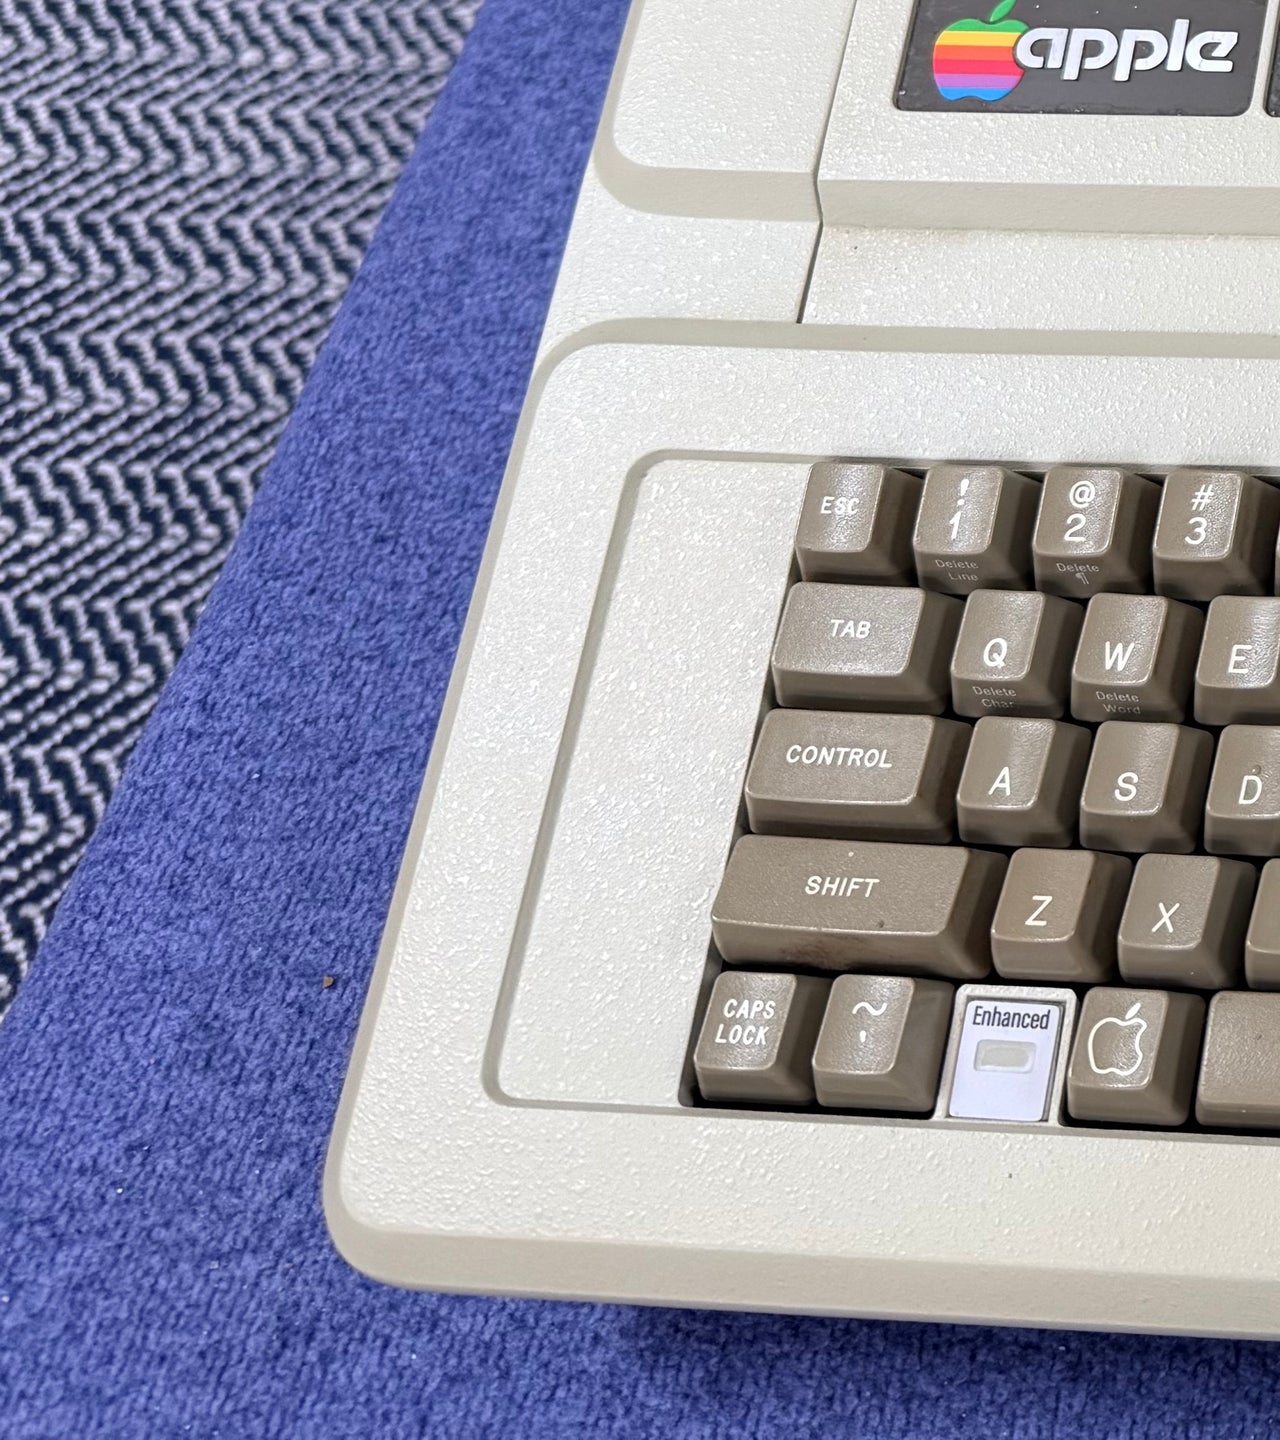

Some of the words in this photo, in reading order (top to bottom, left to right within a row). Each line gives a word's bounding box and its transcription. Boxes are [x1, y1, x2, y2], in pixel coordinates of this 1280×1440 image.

[1015, 19, 1238, 82] apple
[958, 478, 969, 506] !
[1069, 482, 1095, 507] @
[1192, 484, 1213, 509] #
[820, 496, 859, 515] ESC
[949, 512, 961, 538] 1
[1064, 514, 1087, 542] 2
[1184, 518, 1207, 544] 3
[935, 559, 978, 569] Delete
[1056, 563, 1100, 573] Delete
[949, 573, 978, 581] Line
[829, 619, 871, 638] TAB
[984, 638, 1008, 668] Q
[1105, 641, 1134, 670] W
[1229, 643, 1253, 674] E
[973, 686, 1016, 697] Delete
[1096, 691, 1139, 703] Delete
[1103, 703, 1141, 714] Word
[786, 744, 892, 769] CONTROL
[989, 767, 1011, 797] A
[1114, 771, 1137, 801] S
[1238, 774, 1263, 804] D
[803, 875, 879, 899] SHIFT
[1025, 895, 1052, 926] Z
[1151, 903, 1180, 933] X
[723, 998, 775, 1020] CAPS
[972, 1005, 1050, 1030] Enhanced
[715, 1023, 767, 1045] LOCK
